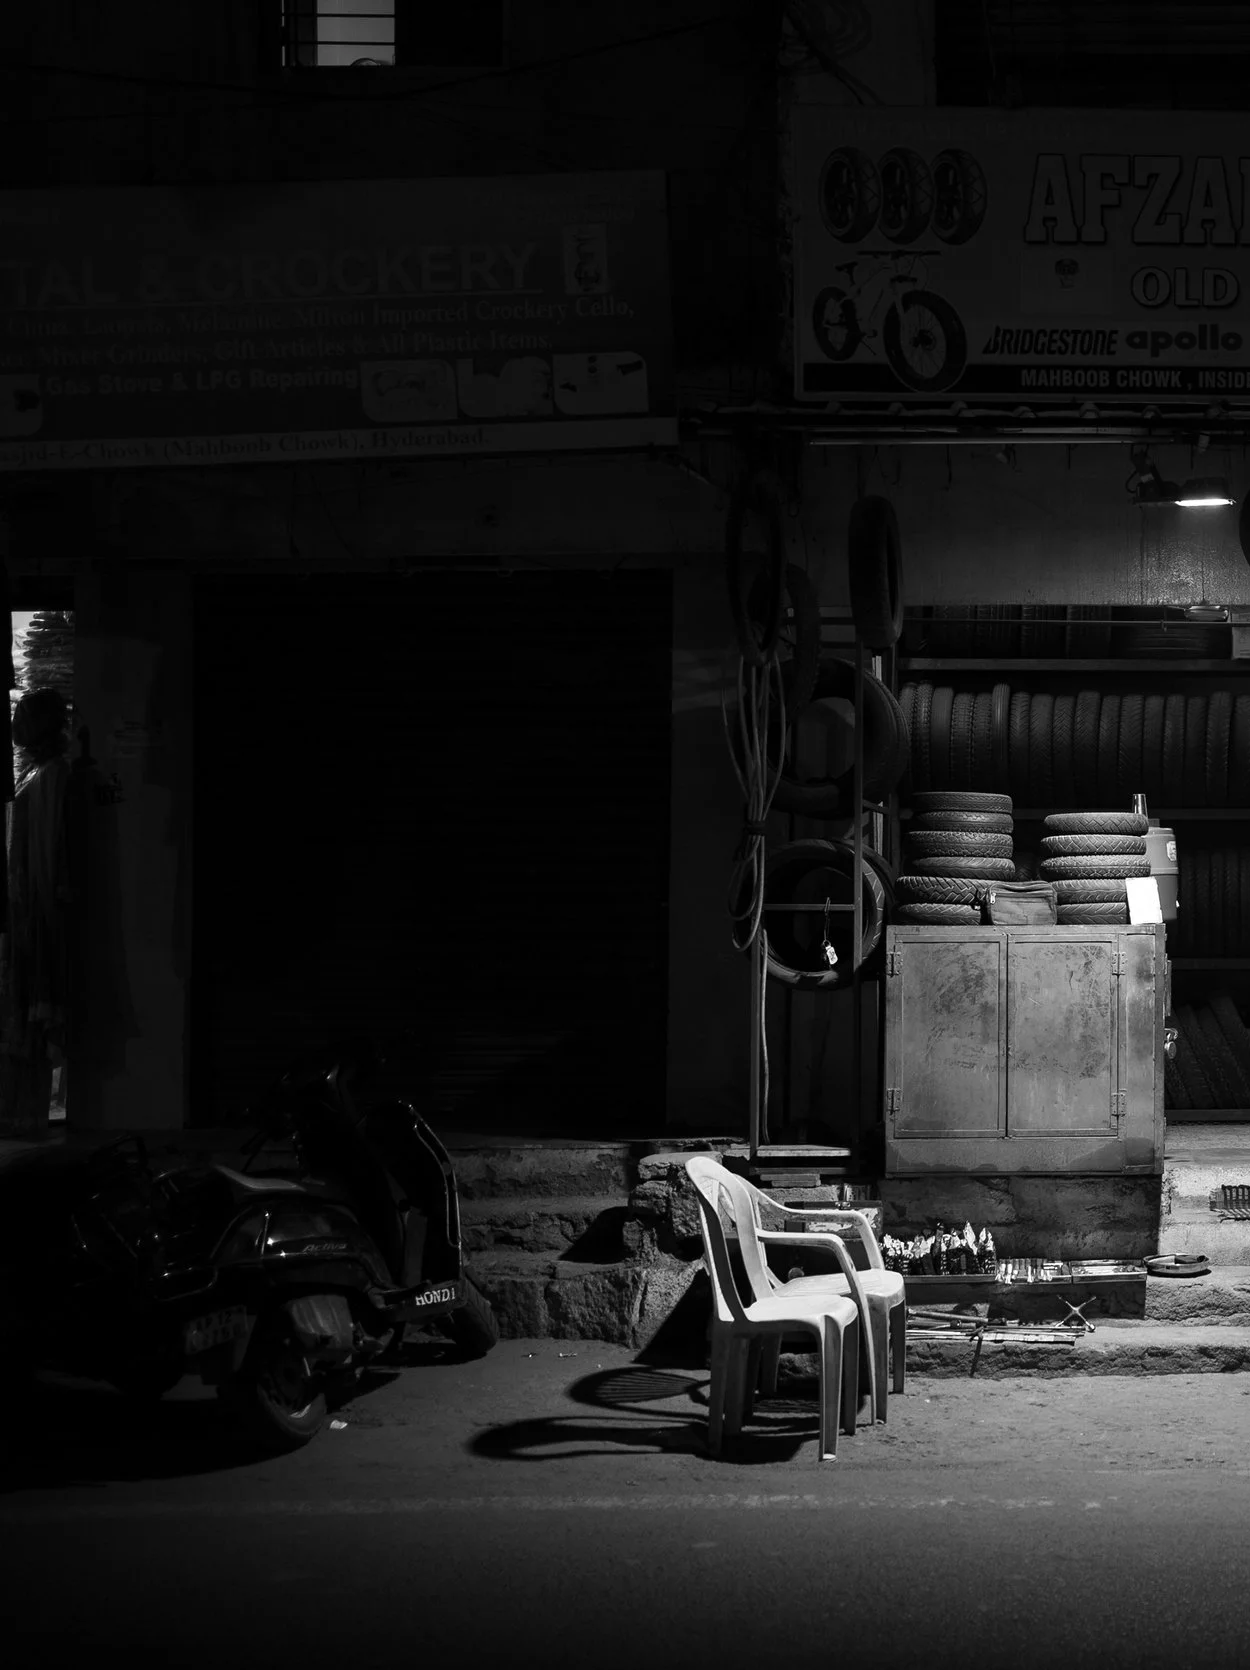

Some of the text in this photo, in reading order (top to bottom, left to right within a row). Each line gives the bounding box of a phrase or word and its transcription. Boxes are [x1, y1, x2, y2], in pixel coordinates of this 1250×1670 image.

[134, 254, 179, 304] &
[195, 241, 538, 300] CROCKERY
[1130, 266, 1240, 309] OLD
[373, 301, 468, 330] Imported
[475, 298, 569, 325] Crockery
[575, 295, 635, 319] Cello,
[264, 335, 346, 360] Articles
[352, 334, 369, 354] &
[378, 331, 405, 354] All
[413, 329, 482, 353] Plastic
[982, 325, 1119, 356] BRIDGESTONE
[1125, 323, 1244, 357] apollo
[46, 365, 359, 396] Gas Stove & LPG Repairing
[1020, 369, 1111, 388] MAHBOOB
[302, 1242, 348, 1253] Activa
